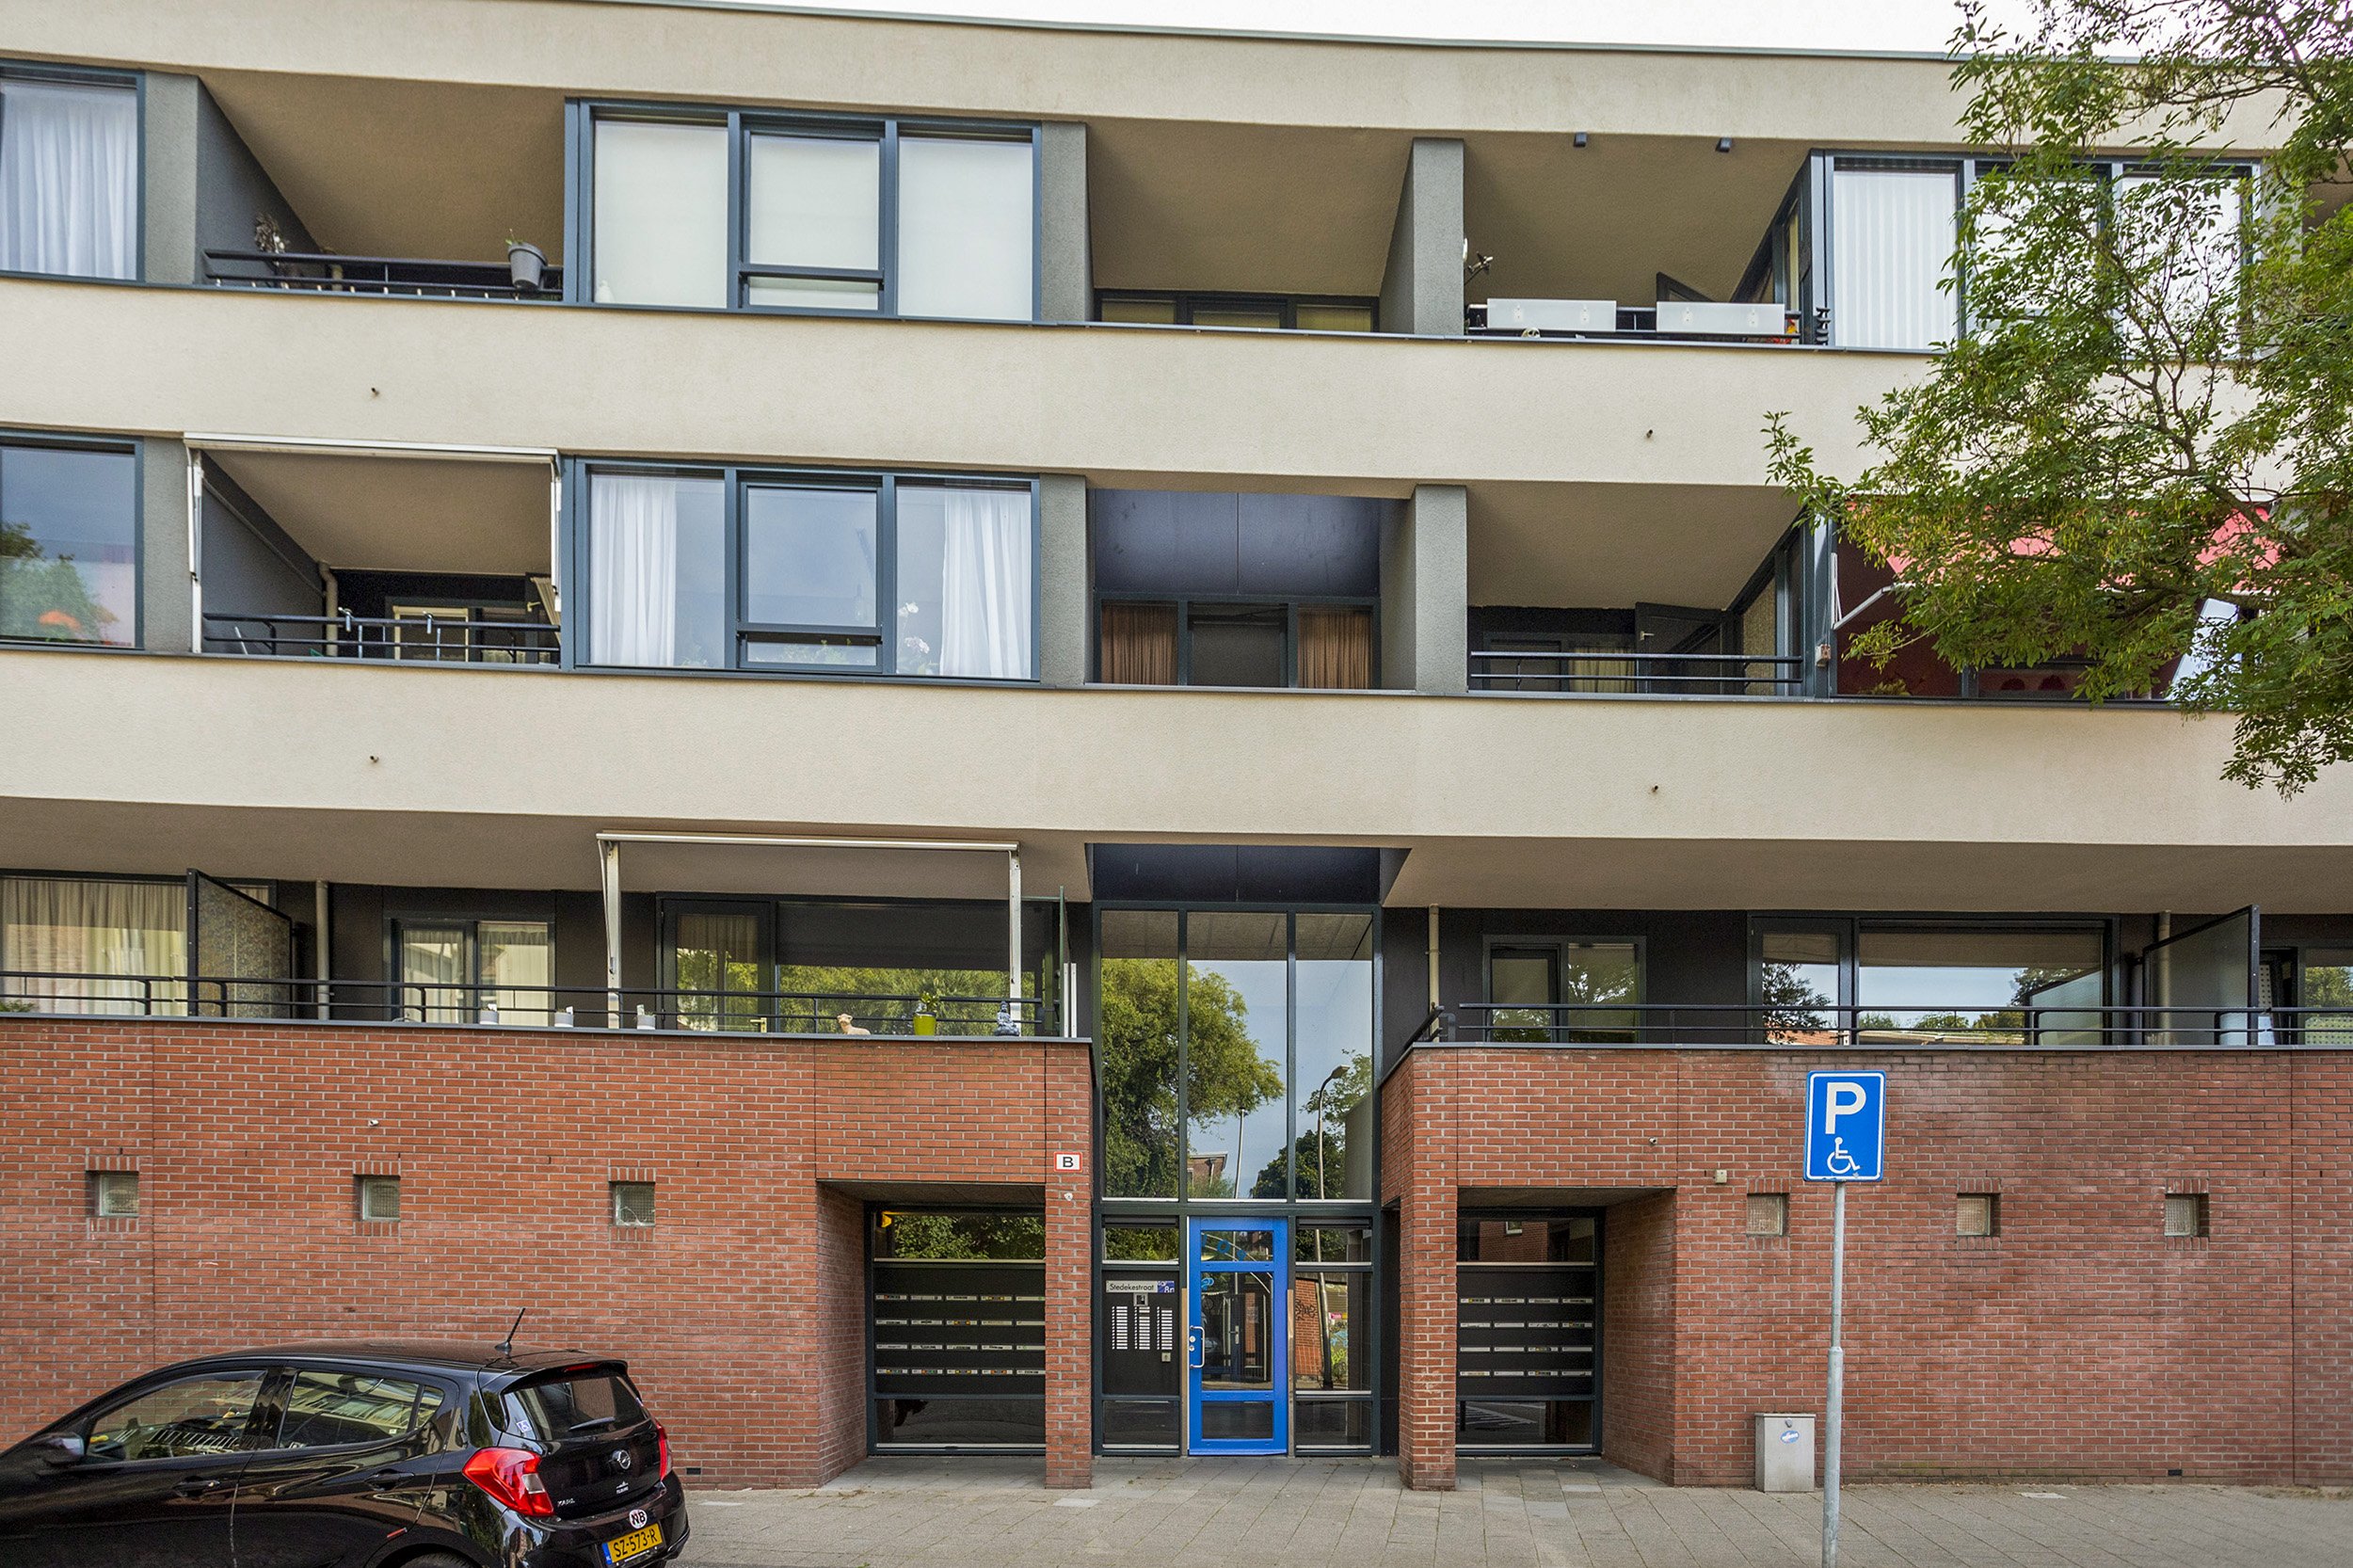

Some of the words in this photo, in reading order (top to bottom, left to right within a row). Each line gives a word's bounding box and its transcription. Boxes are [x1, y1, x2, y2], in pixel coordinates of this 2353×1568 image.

[1825, 1081, 1866, 1134] P
[1063, 1156, 1074, 1168] B
[632, 1511, 647, 1525] NB
[613, 1528, 658, 1558] SZ-573-R
